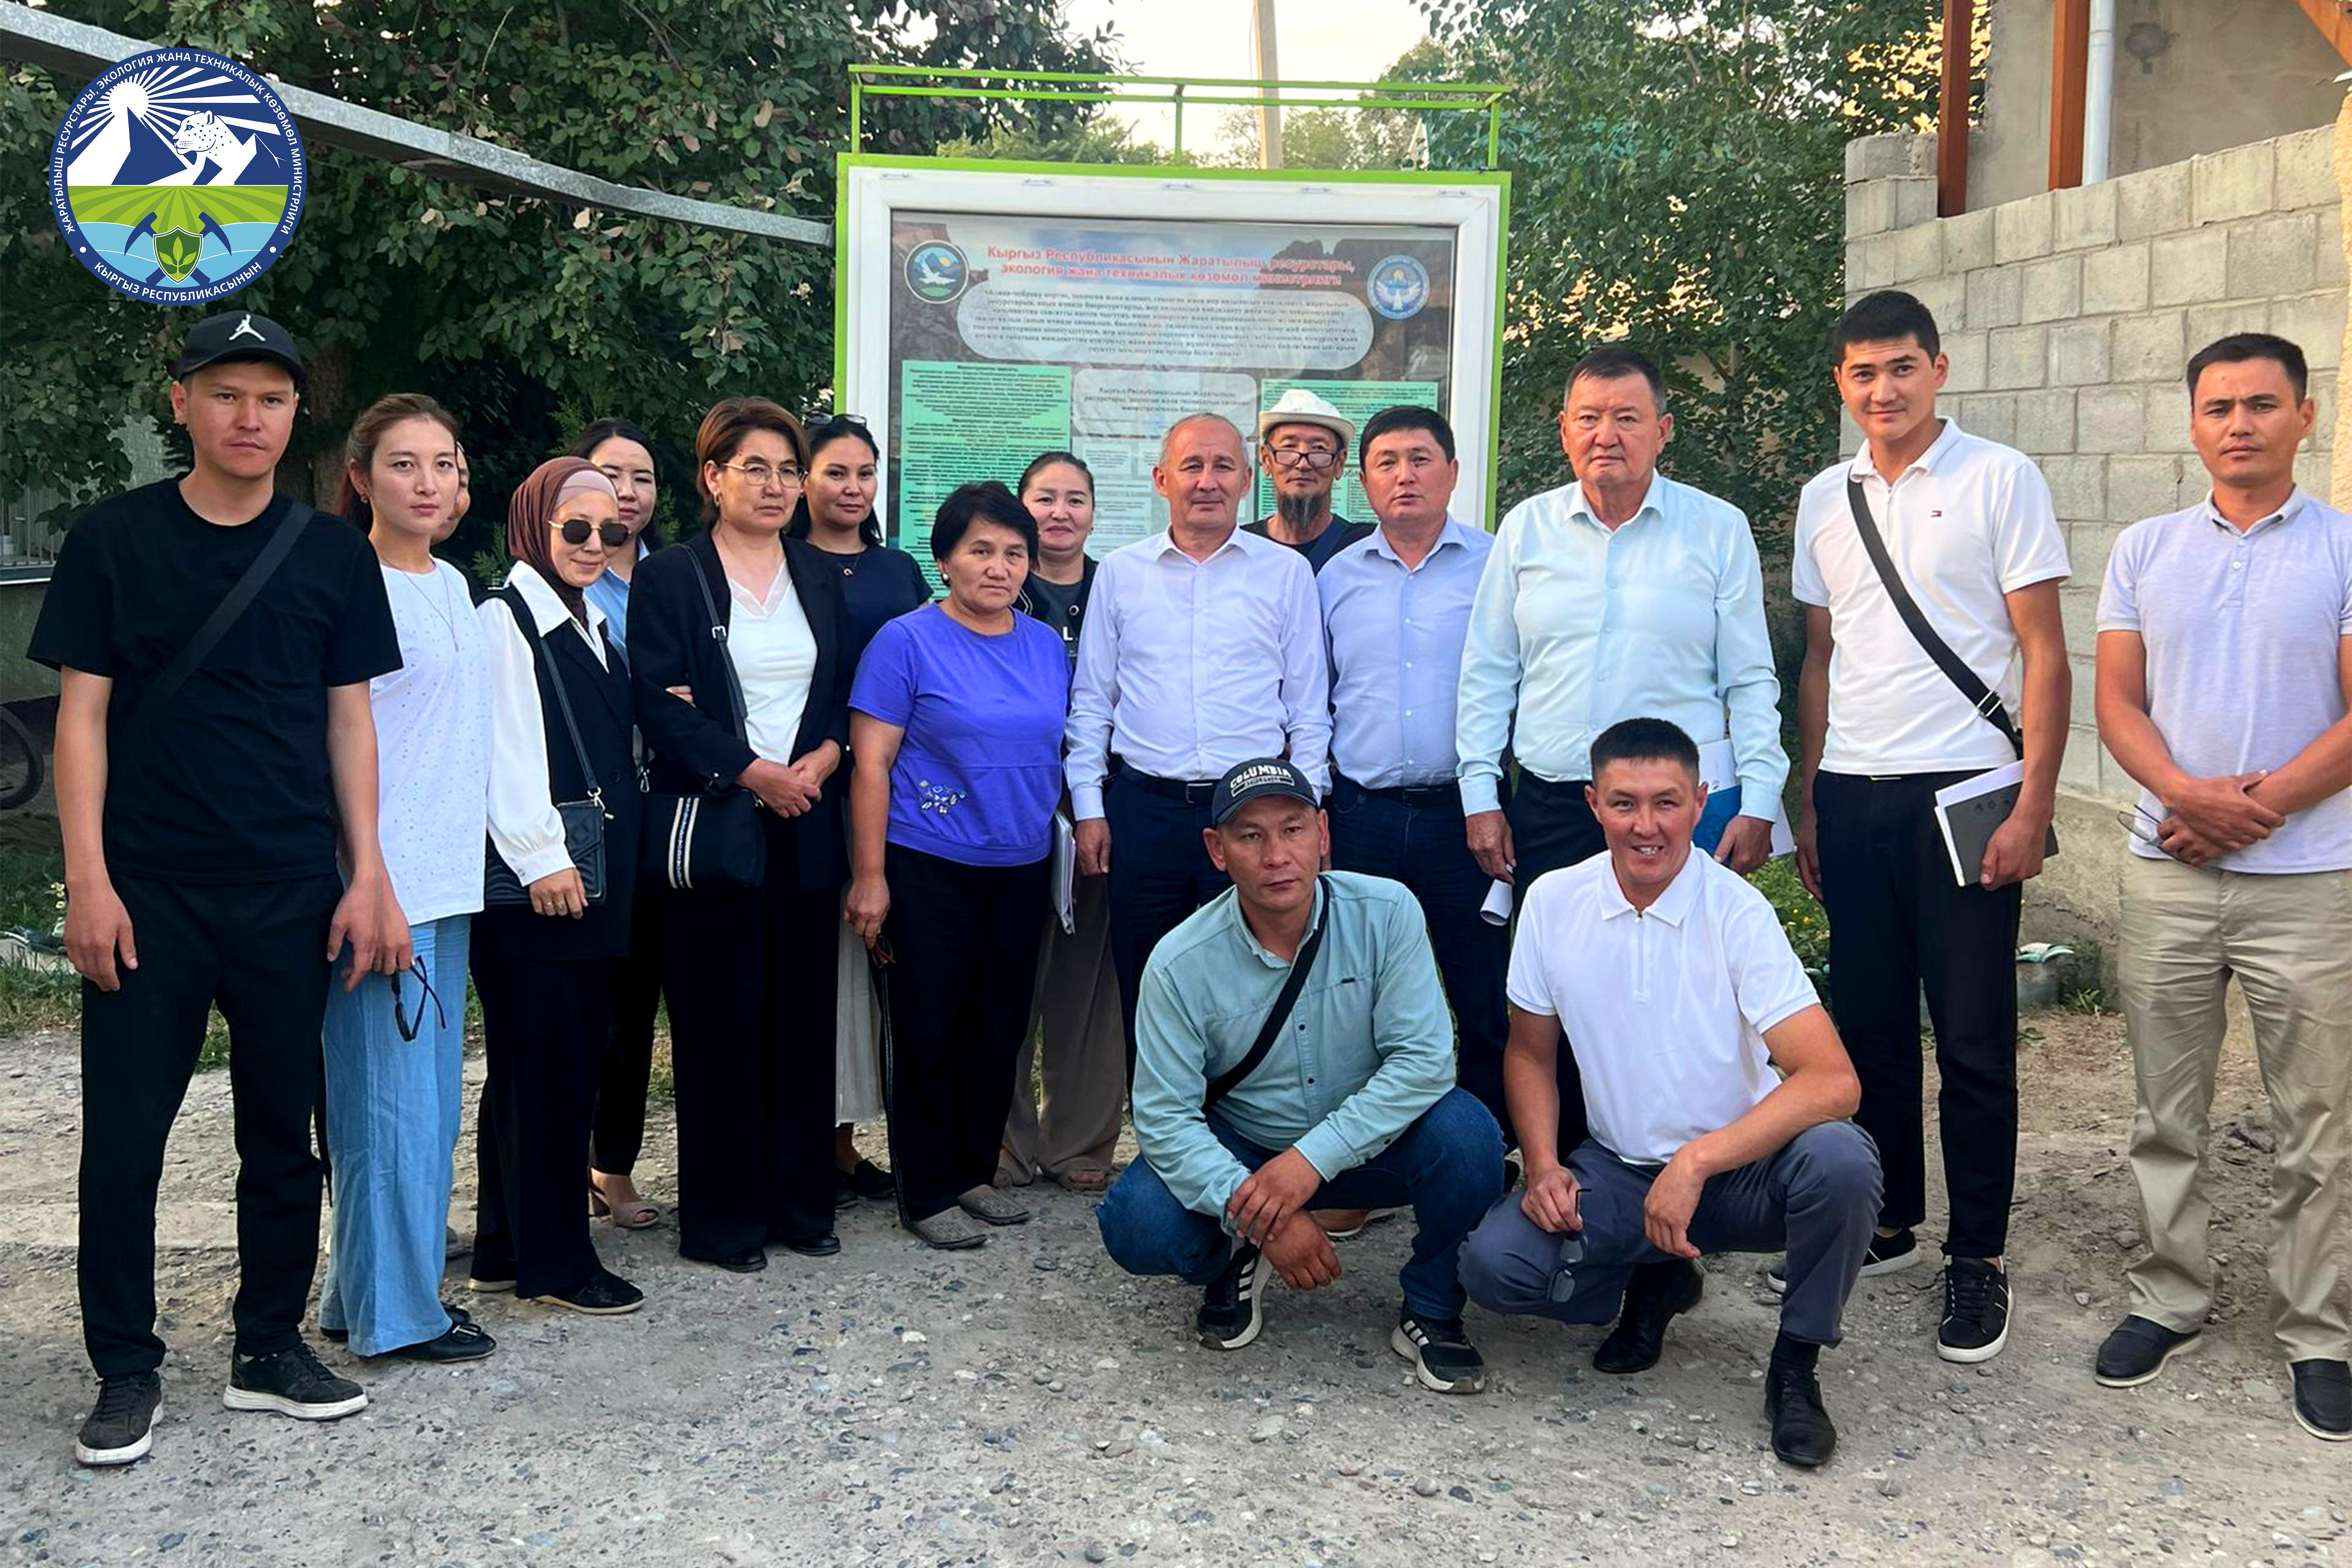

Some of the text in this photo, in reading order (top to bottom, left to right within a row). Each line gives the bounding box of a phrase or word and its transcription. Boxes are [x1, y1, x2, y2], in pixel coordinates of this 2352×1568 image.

[987, 246, 1041, 260] Кыргыз
[1046, 249, 1175, 265] Республикасынын
[1001, 264, 1062, 274] экология
[1230, 765, 1292, 788] COLUMBIA
